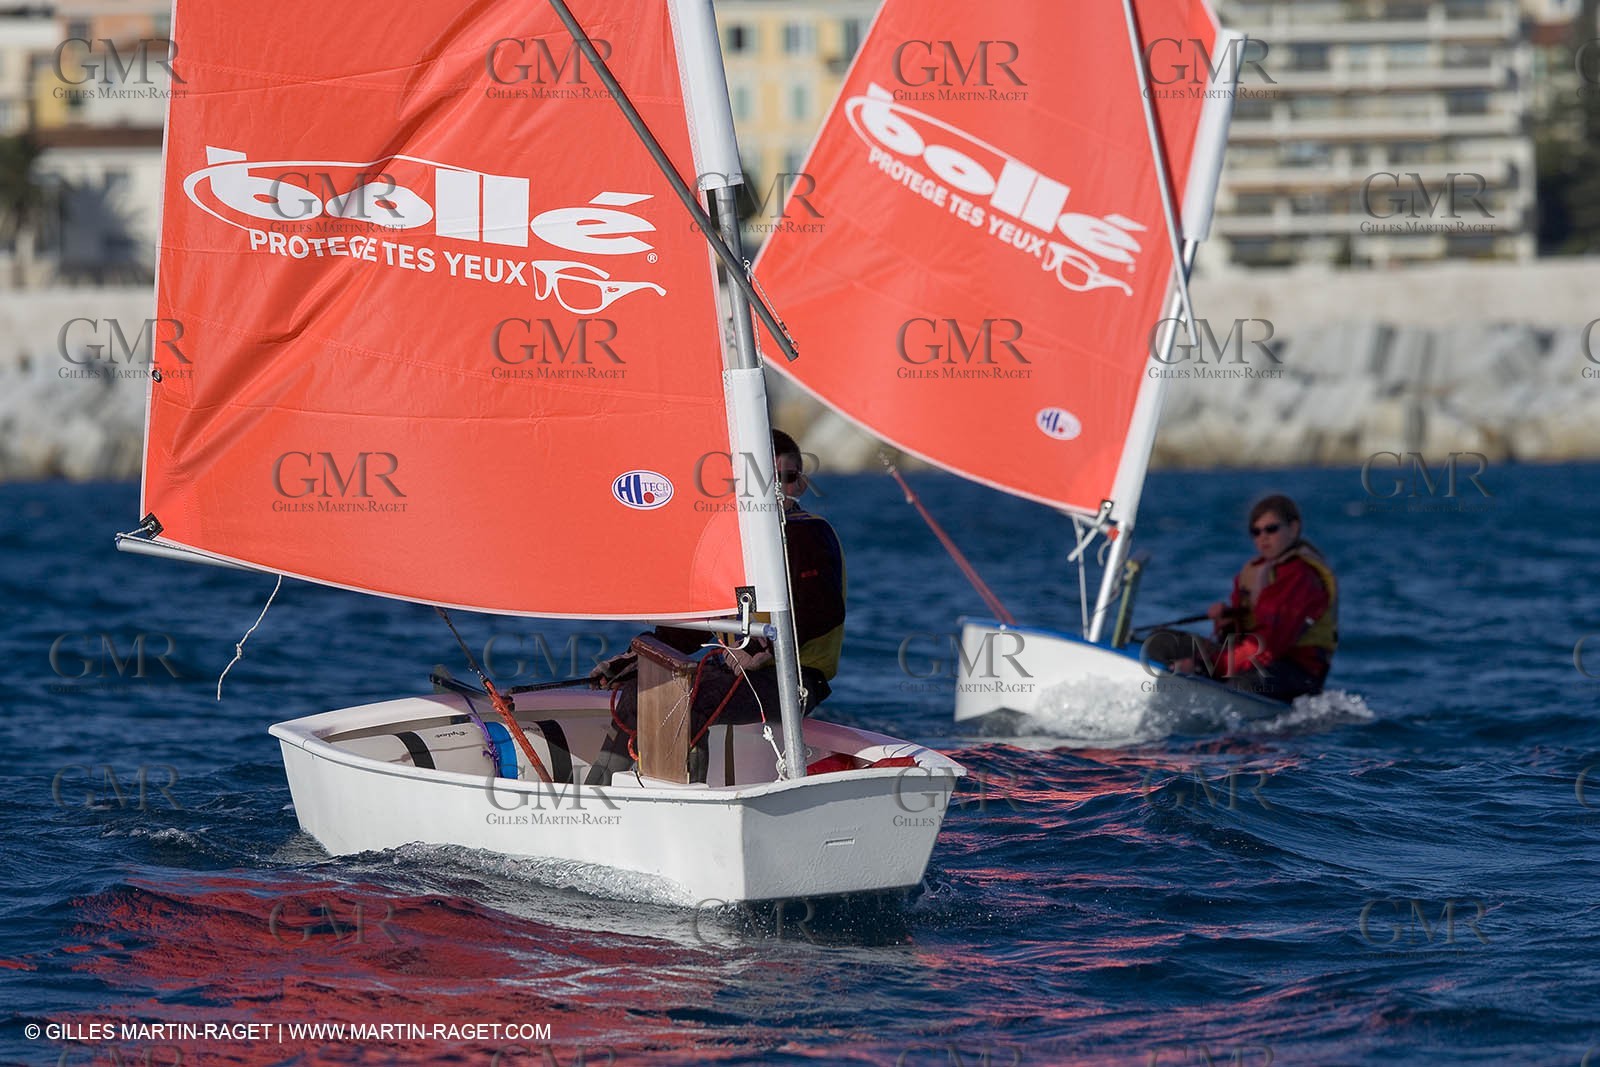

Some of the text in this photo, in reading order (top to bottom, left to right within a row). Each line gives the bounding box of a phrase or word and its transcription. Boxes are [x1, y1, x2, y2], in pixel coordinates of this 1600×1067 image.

[183, 145, 657, 255] bollé
[845, 82, 1147, 264] bollé
[868, 147, 1046, 258] PROTEGE TES YEUX
[249, 228, 528, 287] PROTEGE TES YEUX
[641, 481, 669, 492] TECH
